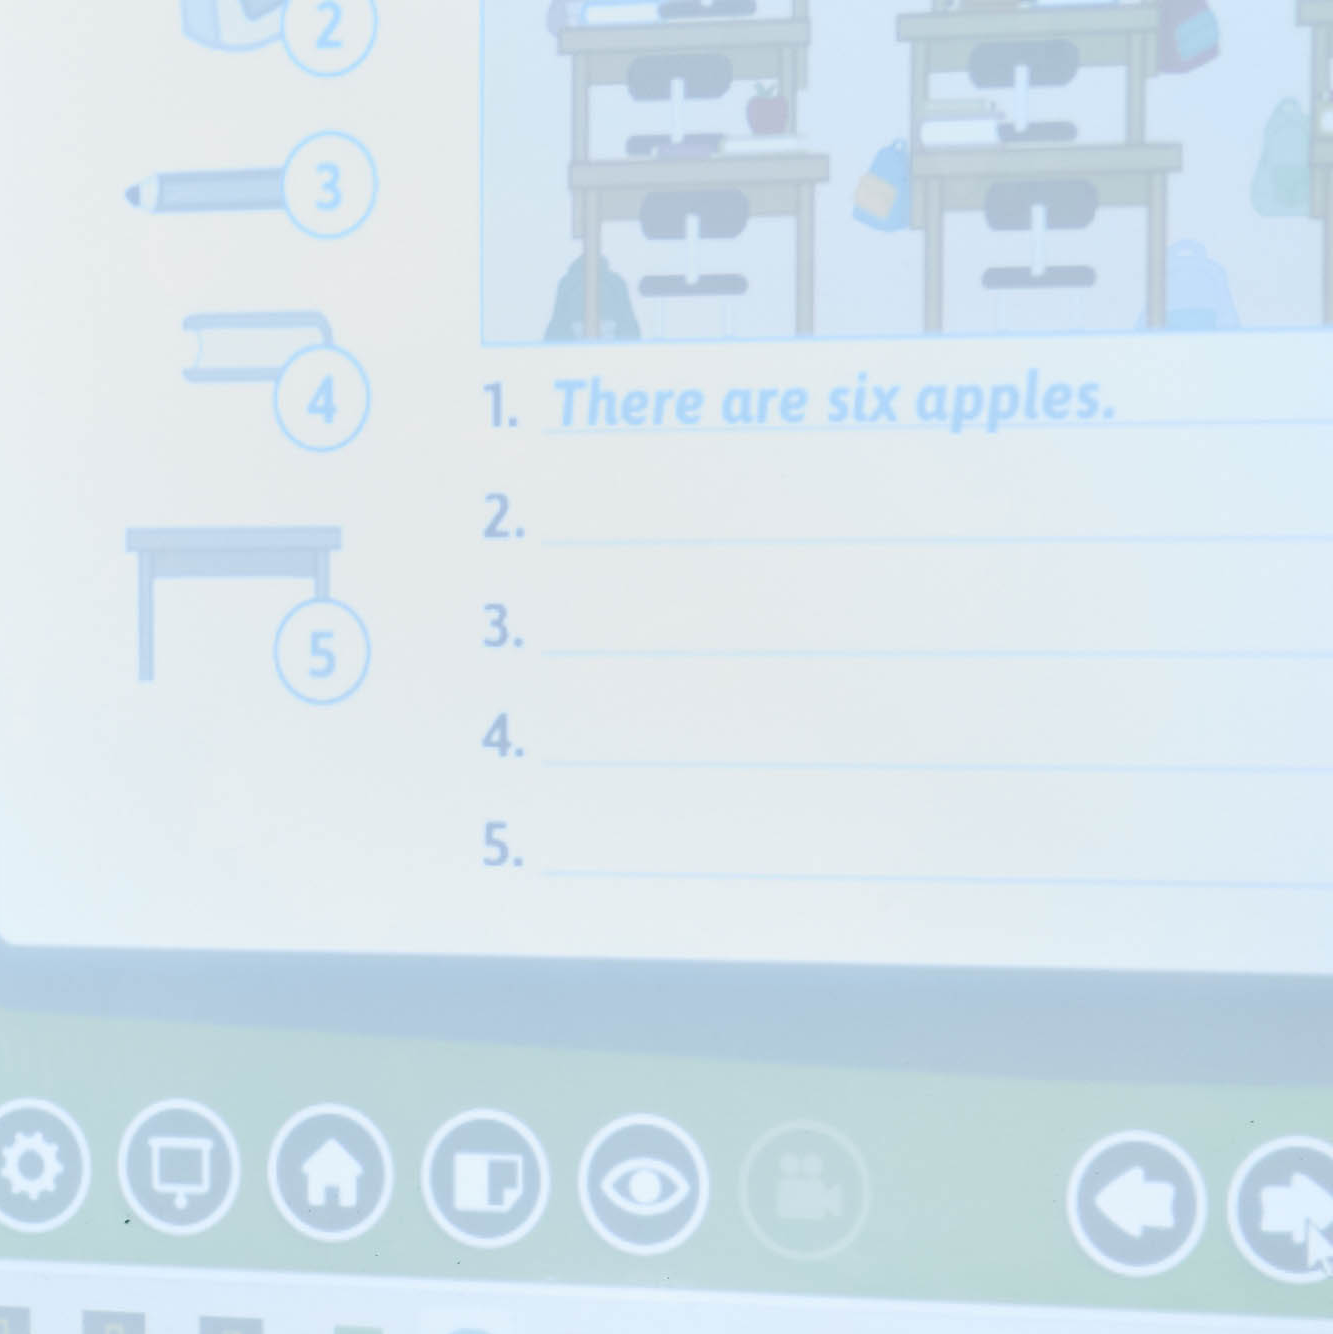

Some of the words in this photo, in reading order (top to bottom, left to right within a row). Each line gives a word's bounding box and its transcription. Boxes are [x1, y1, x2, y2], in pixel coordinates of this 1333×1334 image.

[316, 0, 342, 49] 2
[314, 163, 341, 211] 3
[306, 375, 338, 424] 4
[483, 381, 518, 427] 1.
[554, 376, 705, 427] There
[721, 386, 808, 424] are
[828, 372, 901, 422] six
[914, 367, 1115, 433] apples.
[483, 492, 525, 540] 2.
[483, 603, 524, 648] 3.
[309, 630, 336, 678] 5
[481, 712, 525, 757] 4.
[483, 820, 524, 867] 5.
